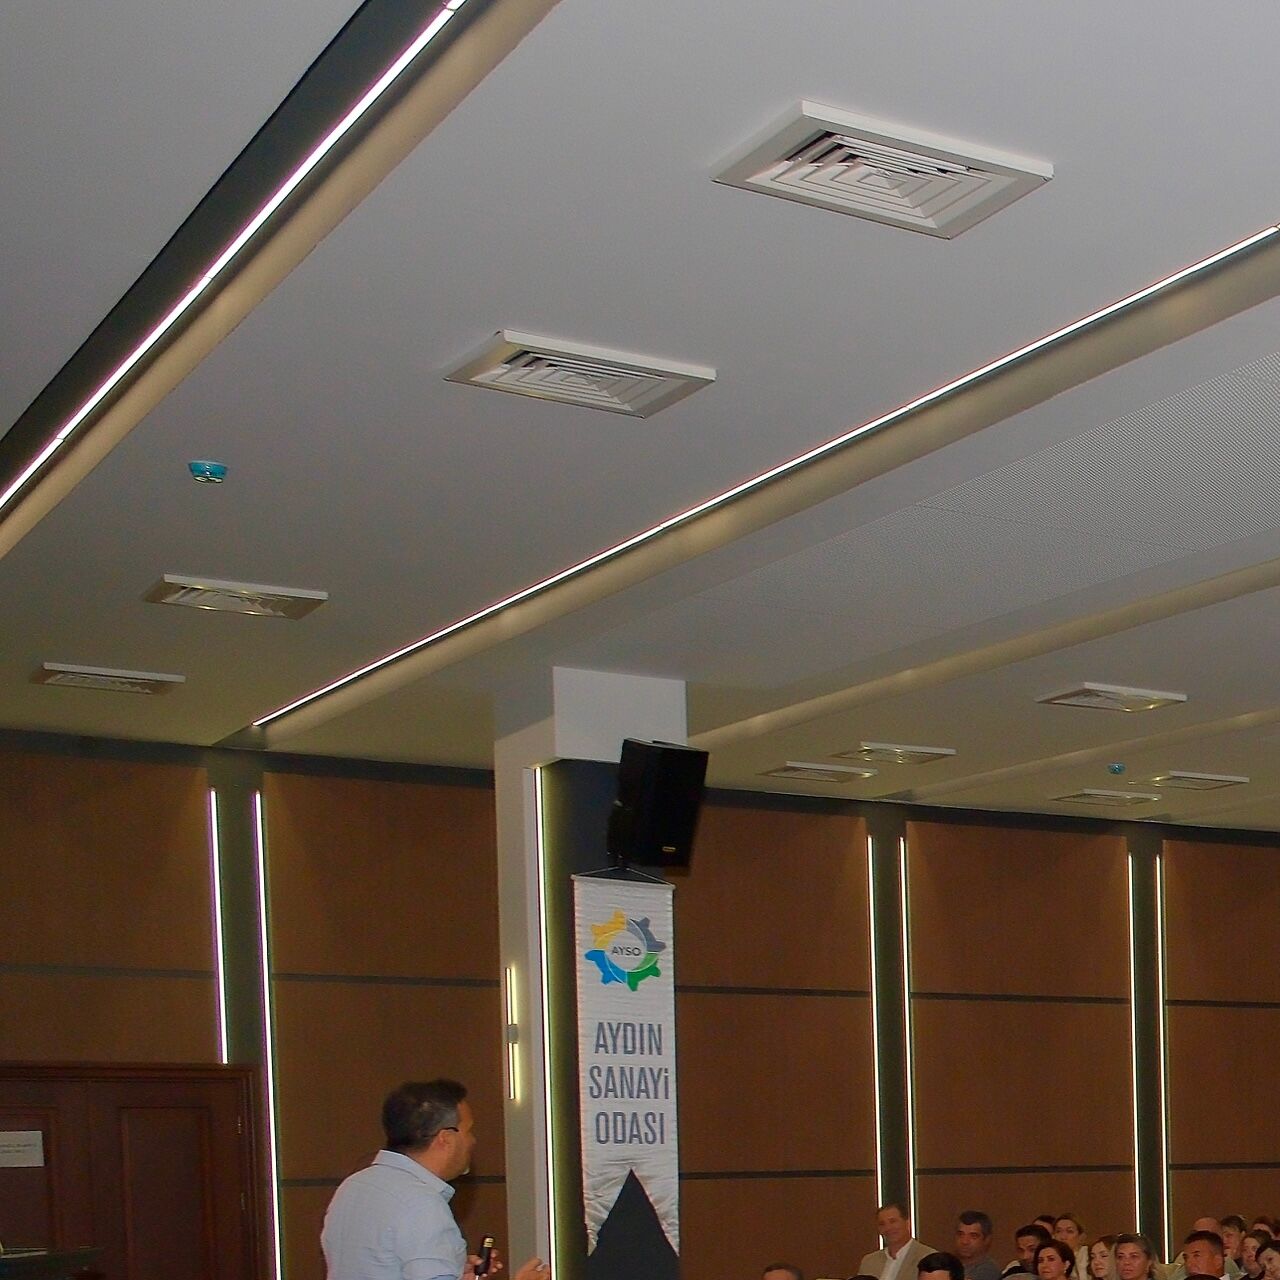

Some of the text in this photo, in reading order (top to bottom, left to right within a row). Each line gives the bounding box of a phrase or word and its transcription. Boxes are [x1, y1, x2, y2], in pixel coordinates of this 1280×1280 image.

[612, 946, 641, 956] AYSO
[594, 1022, 662, 1055] AYDIN
[595, 1111, 665, 1144] ODASI
